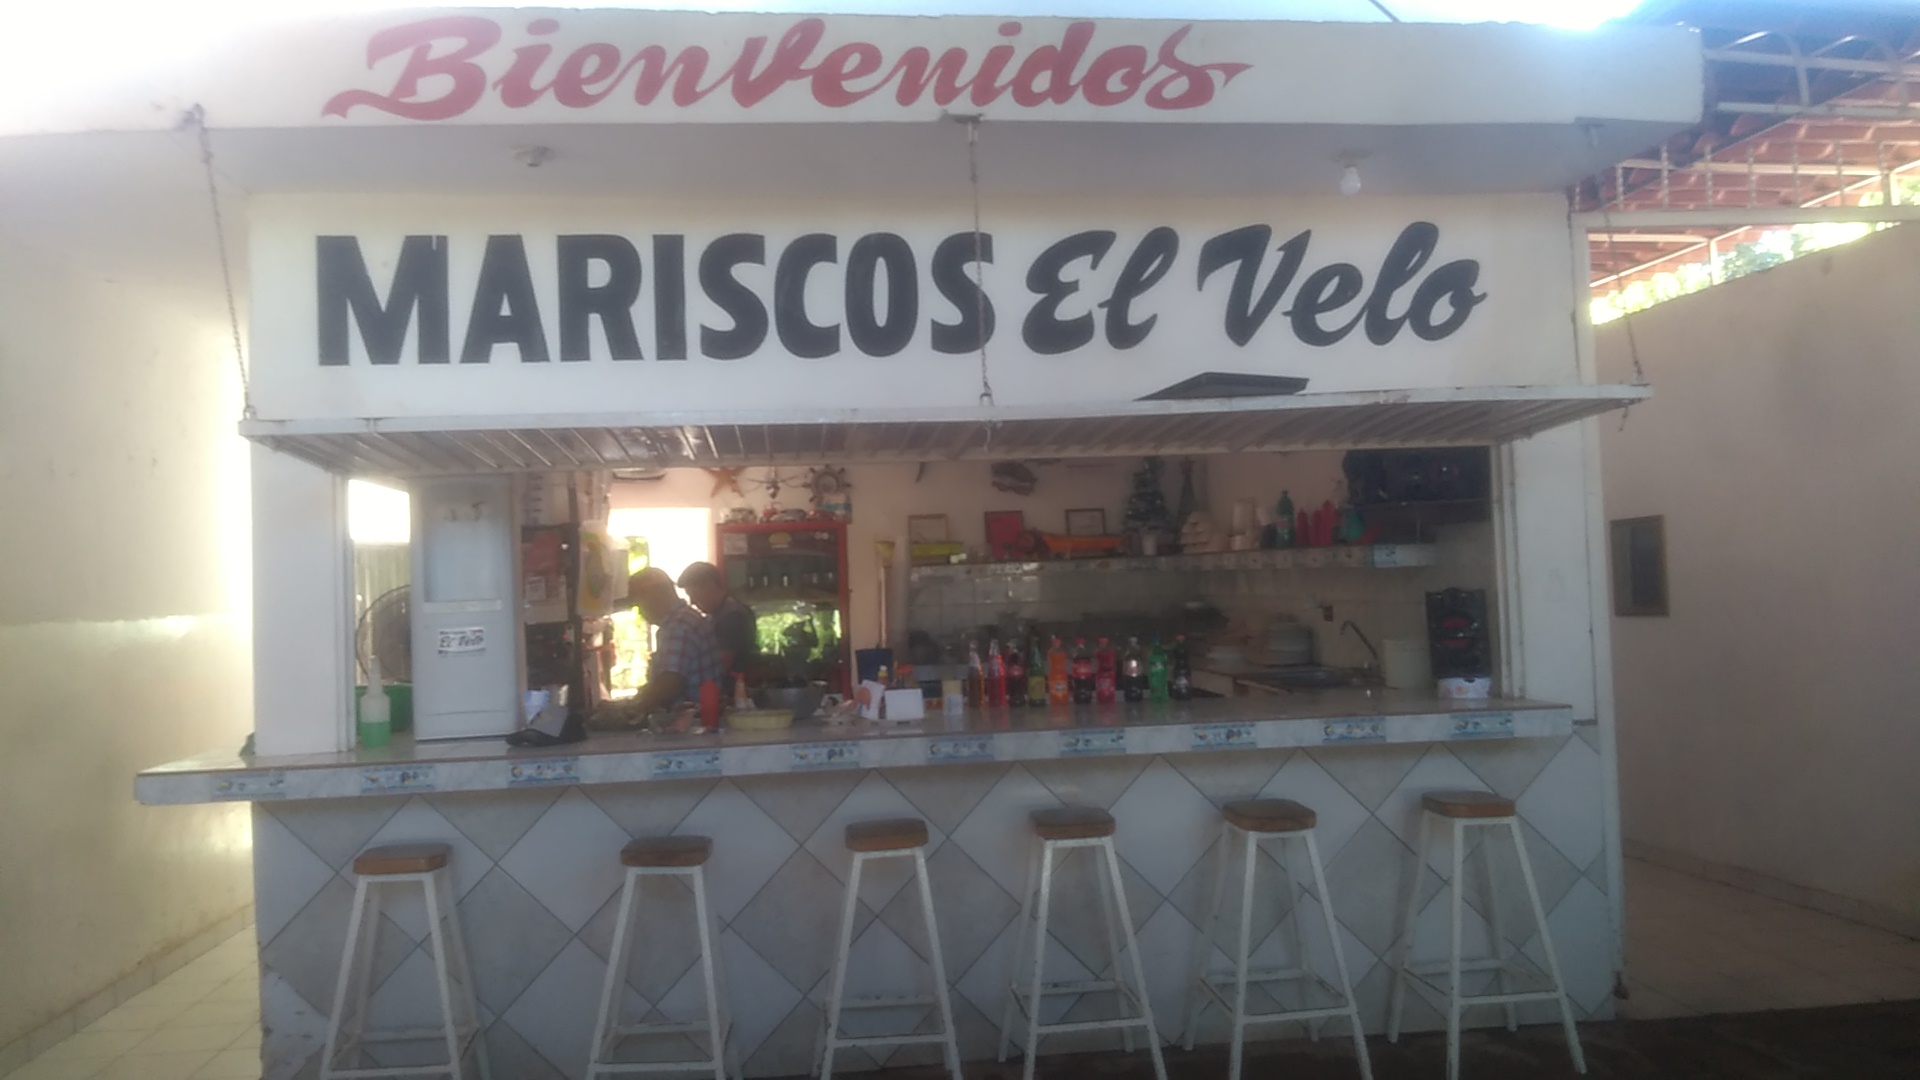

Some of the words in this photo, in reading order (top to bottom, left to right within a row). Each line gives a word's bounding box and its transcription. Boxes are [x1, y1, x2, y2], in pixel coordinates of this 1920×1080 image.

[316, 233, 996, 366] MARISCOS
[1022, 226, 1180, 355] El
[1197, 221, 1488, 347] Velo
